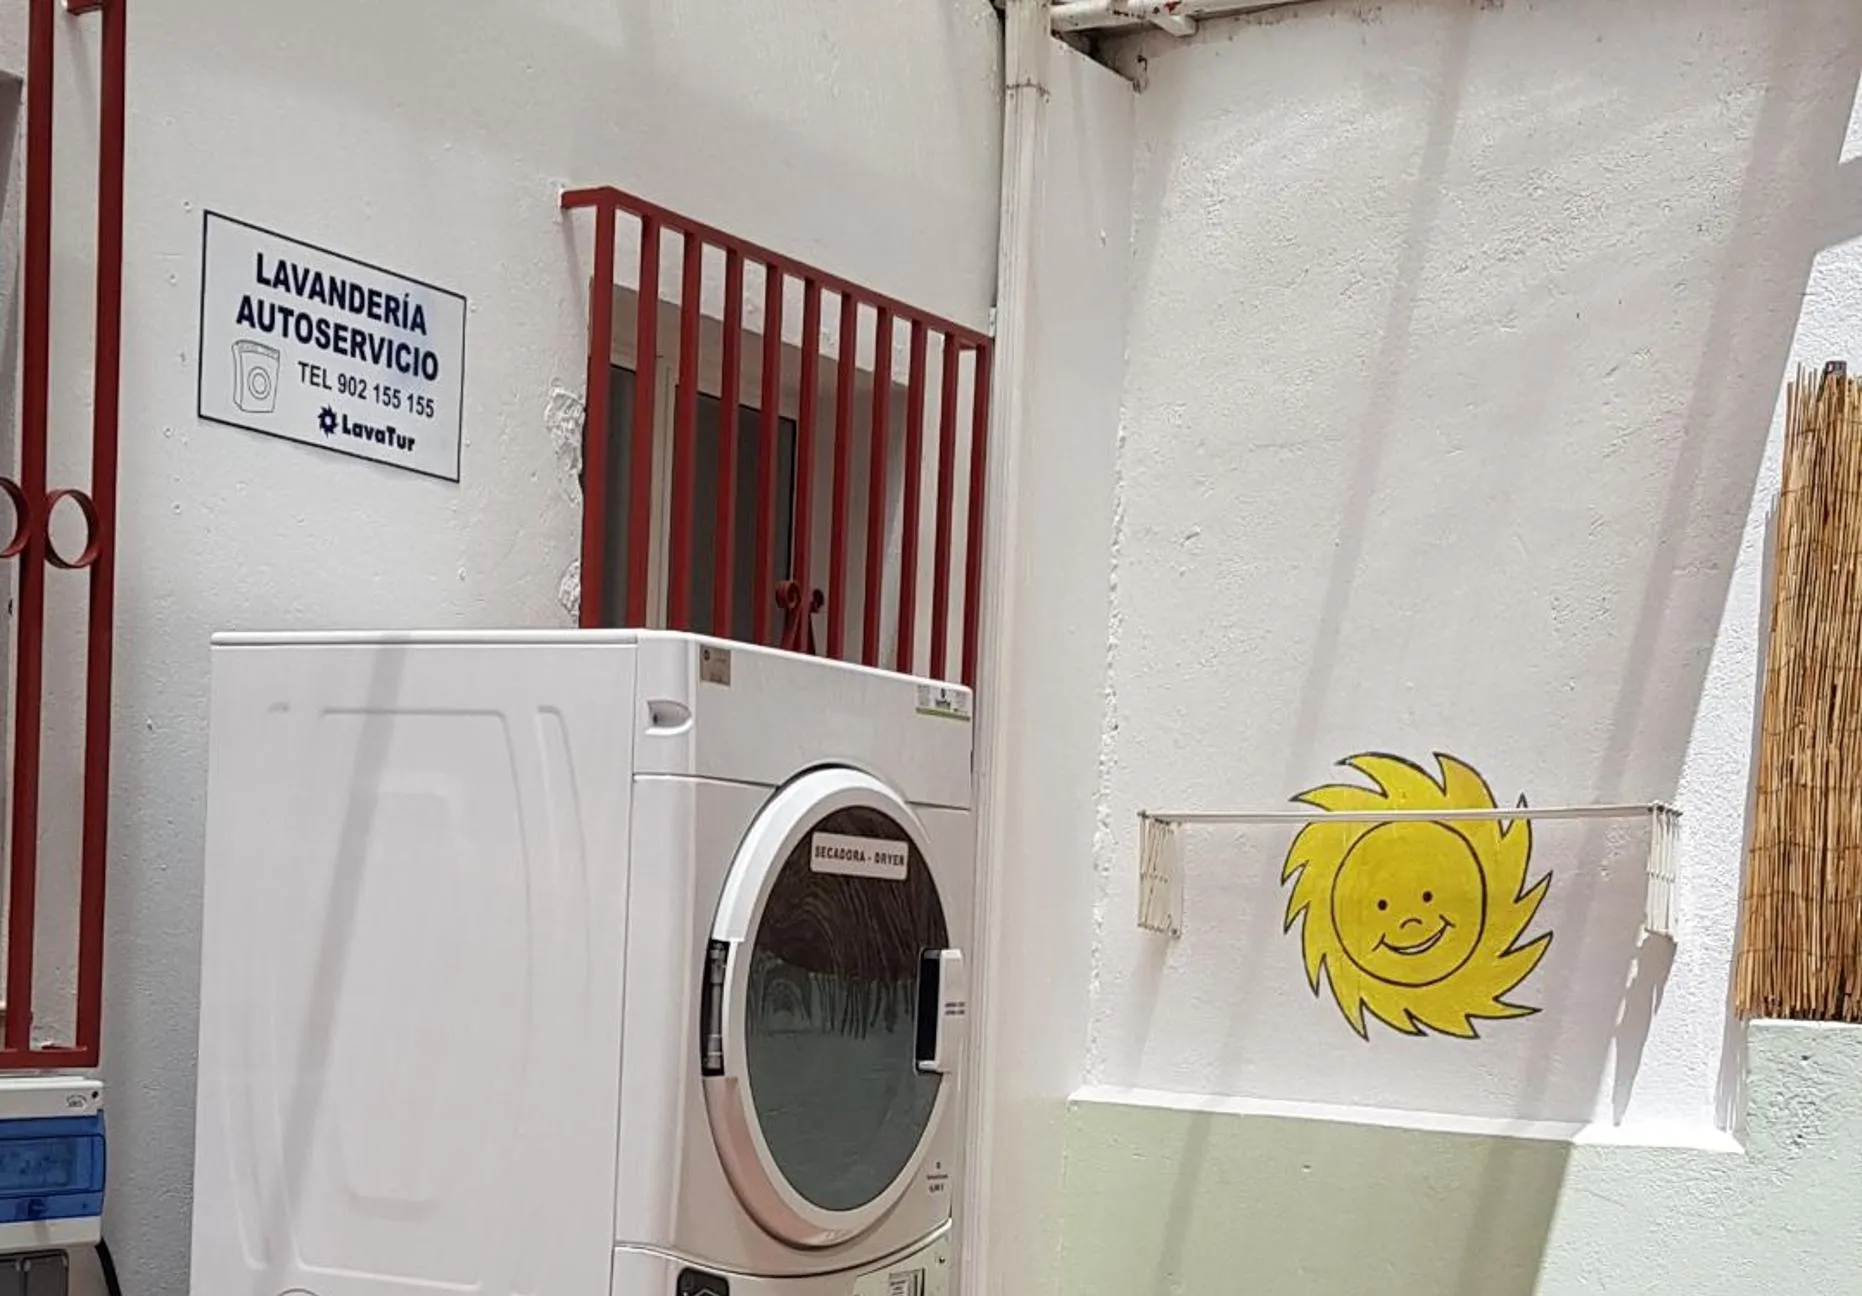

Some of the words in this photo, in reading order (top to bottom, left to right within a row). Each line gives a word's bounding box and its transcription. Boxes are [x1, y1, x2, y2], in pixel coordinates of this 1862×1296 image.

[256, 252, 427, 336] LAVANDERÍA
[236, 294, 439, 381] AUTOSERVICIO
[298, 361, 332, 391] TEL
[338, 373, 367, 400] 902
[374, 383, 401, 409] 155
[407, 393, 434, 419] 155
[342, 414, 415, 452] LavaTur
[815, 845, 866, 863] SECADORA
[874, 851, 905, 866] DRYER
